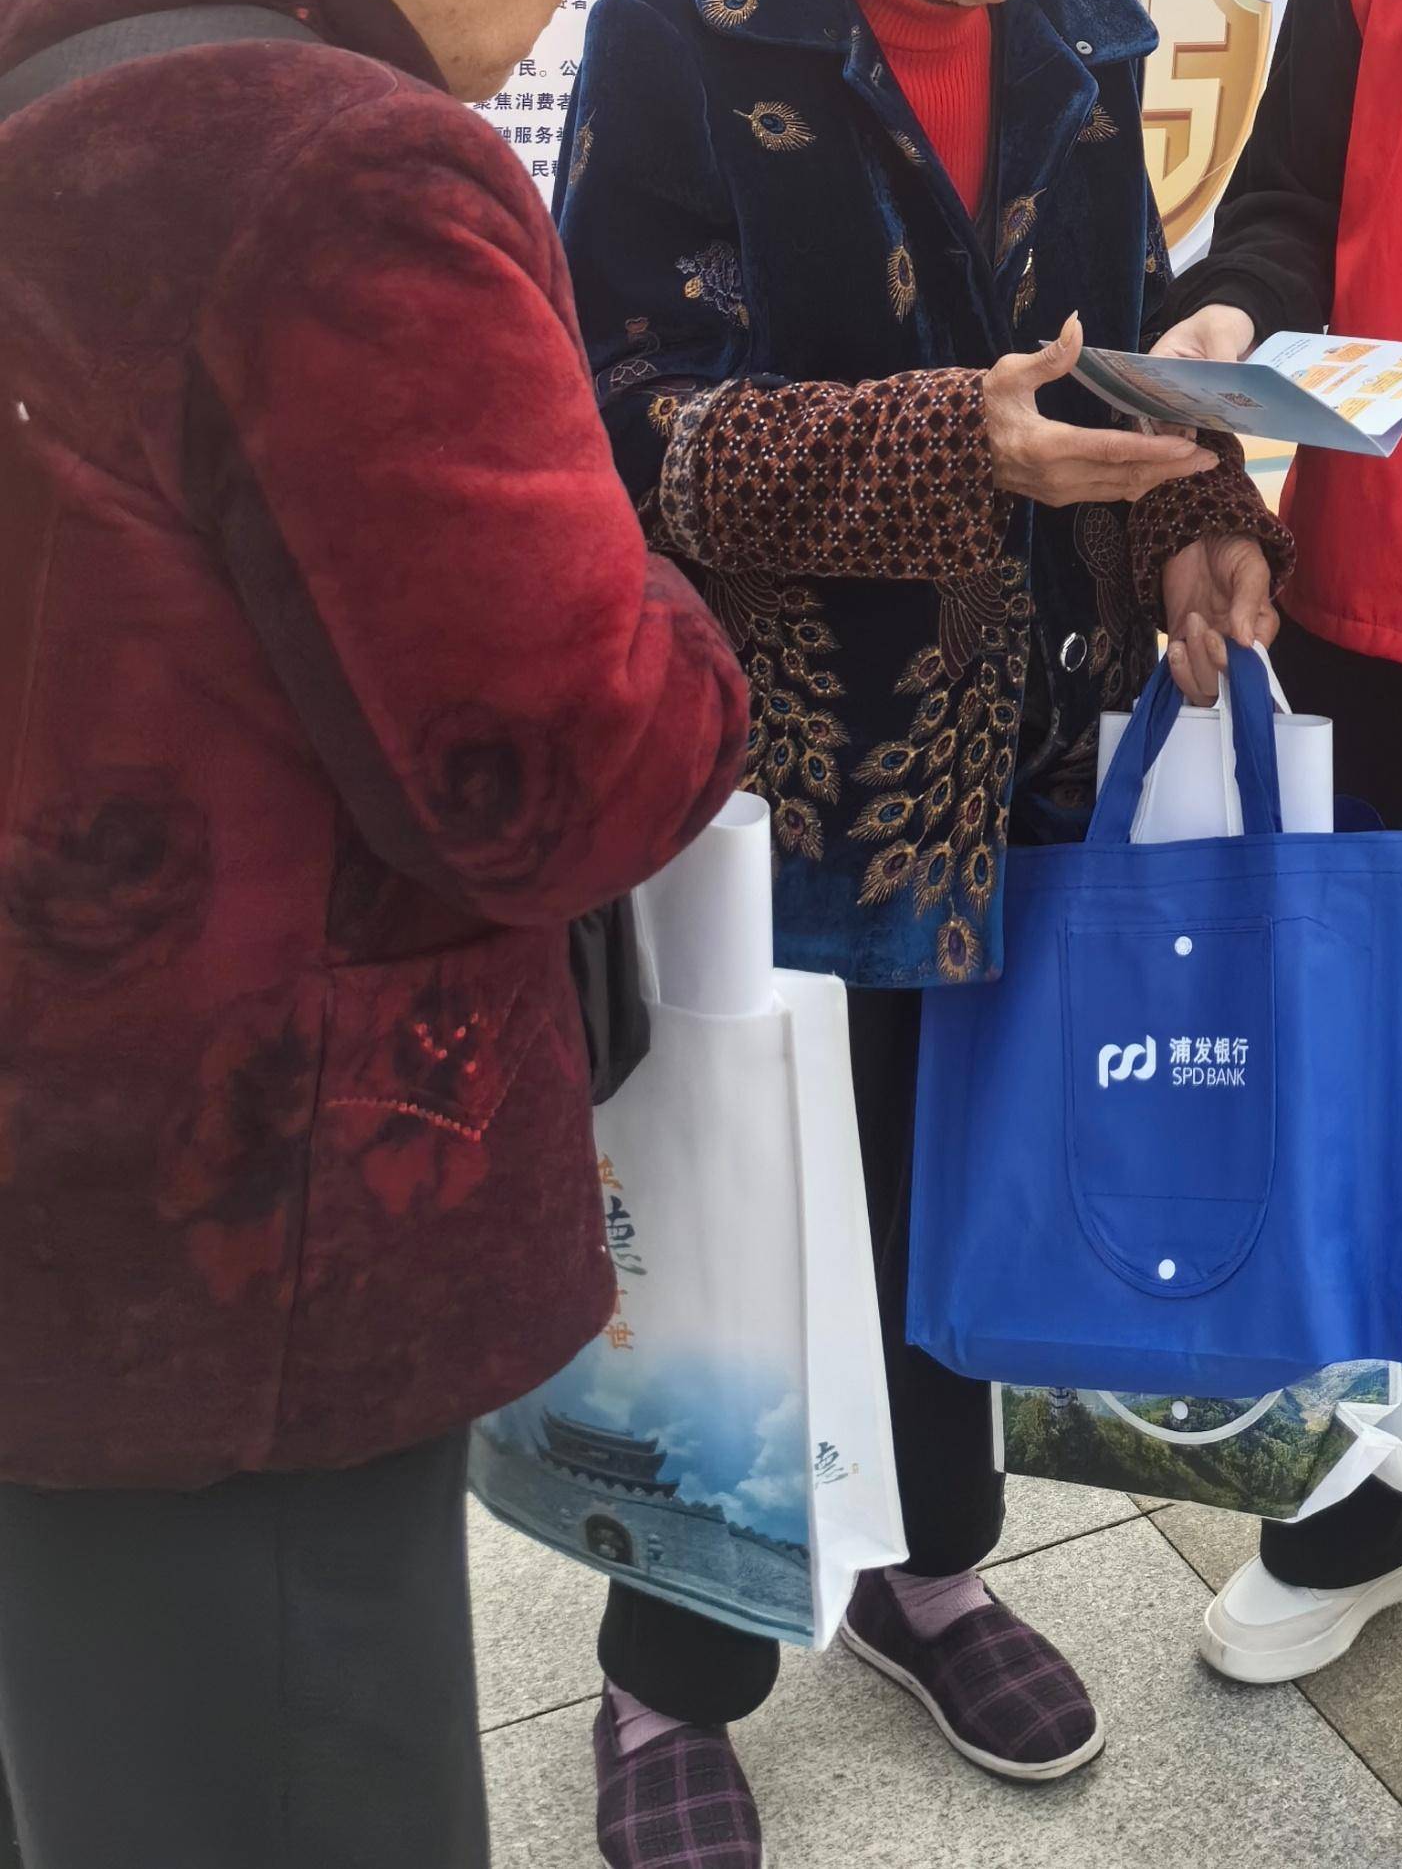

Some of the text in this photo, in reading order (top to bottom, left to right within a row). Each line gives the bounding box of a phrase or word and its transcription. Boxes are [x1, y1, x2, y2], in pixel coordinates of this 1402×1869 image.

[1169, 1036, 1249, 1064] 浦发银行
[1172, 1067, 1246, 1086] SPD BANK
